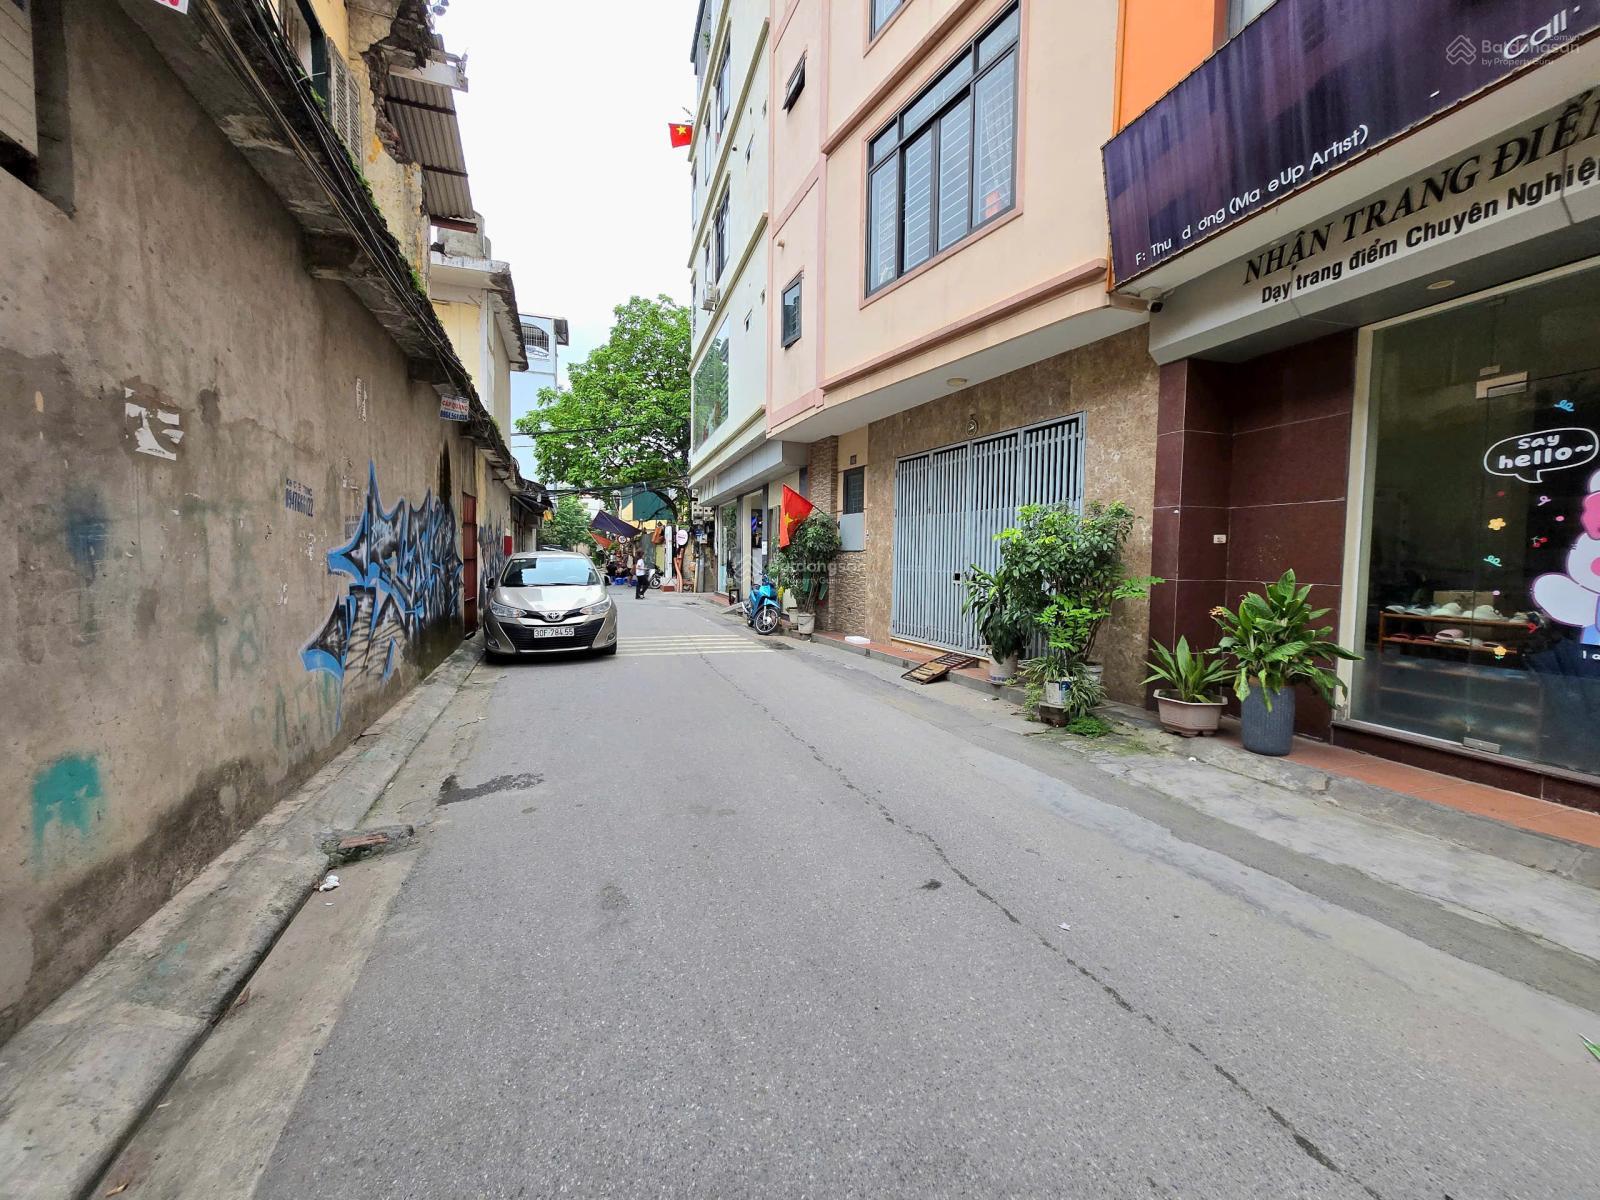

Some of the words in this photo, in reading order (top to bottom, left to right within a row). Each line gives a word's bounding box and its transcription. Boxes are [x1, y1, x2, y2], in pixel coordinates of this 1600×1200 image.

[1151, 238, 1172, 256] Thu
[1309, 124, 1369, 171] Artist)
[1243, 221, 1334, 285] NHẬN
[1342, 154, 1481, 242] TRANG
[1261, 279, 1292, 305] Dạy
[1296, 259, 1343, 291] trang
[1349, 238, 1398, 271] điểm
[1405, 199, 1499, 248] Chuyên
[1507, 156, 1600, 210] Nghiệ
